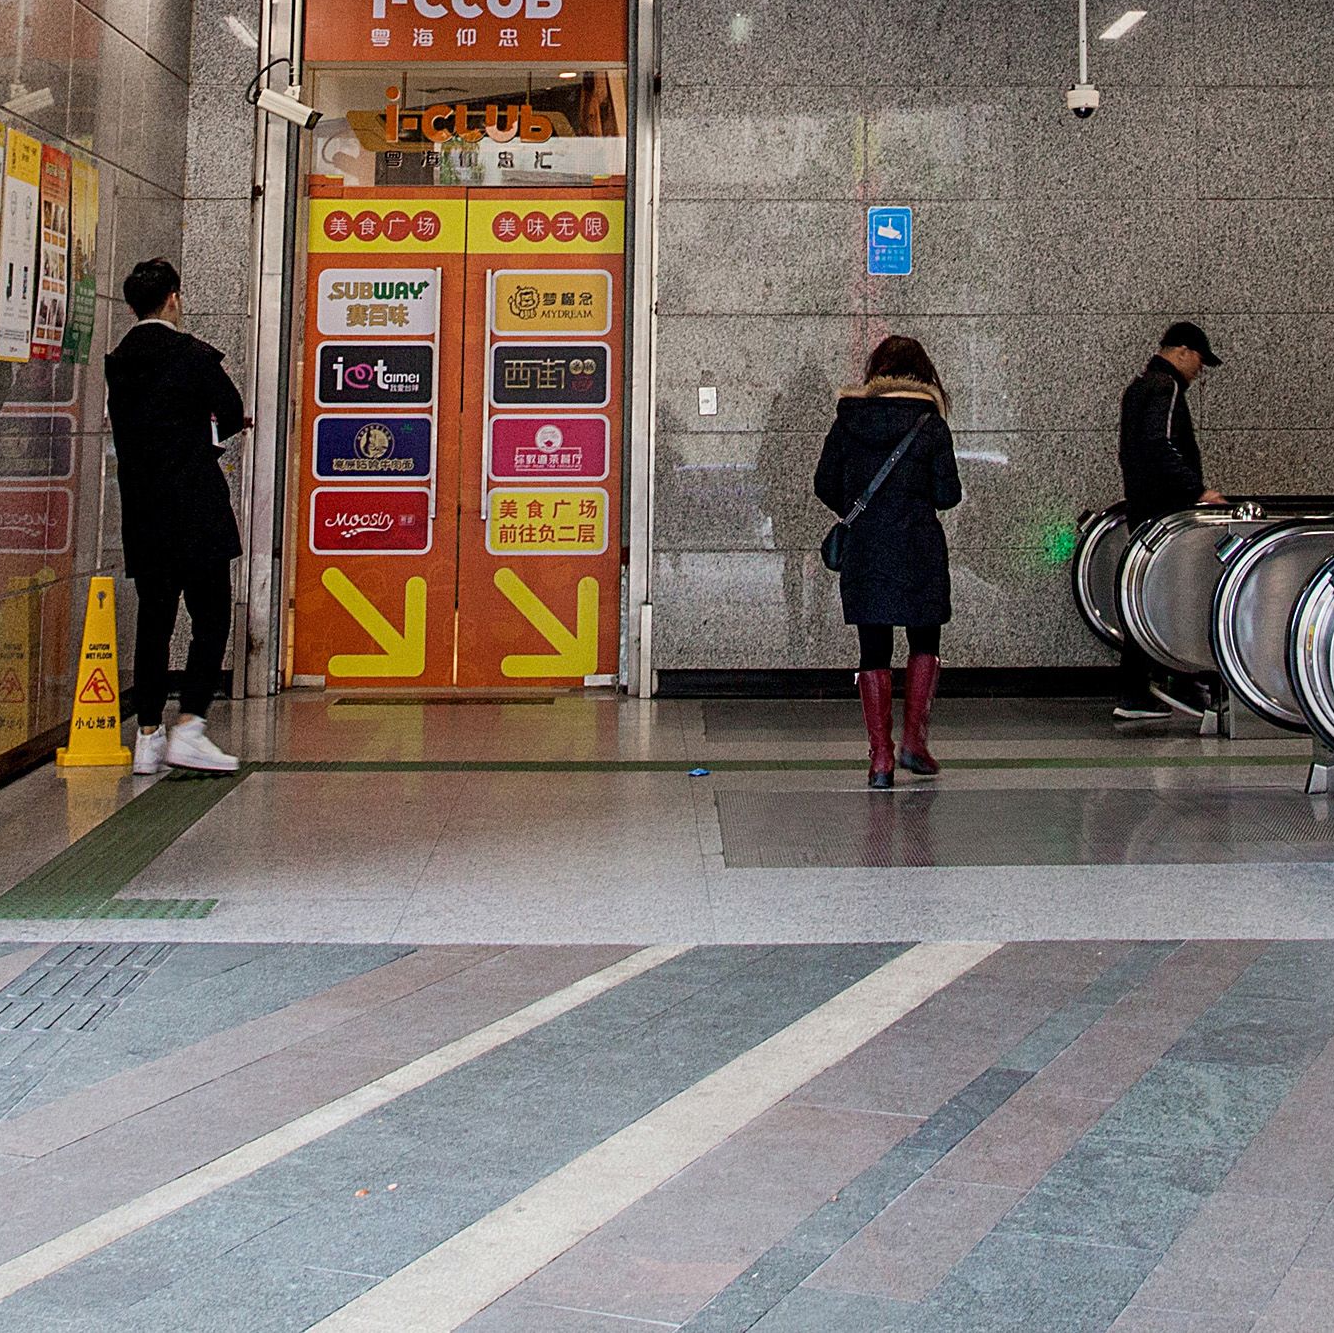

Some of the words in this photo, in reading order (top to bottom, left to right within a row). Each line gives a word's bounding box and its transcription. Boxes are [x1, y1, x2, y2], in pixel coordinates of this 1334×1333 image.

[371, 28, 562, 48] 粤海仰忠汇
[328, 217, 437, 236] 美食广场
[497, 217, 604, 237] 美味无限
[328, 281, 429, 300] SUBWAY
[346, 303, 409, 327] 赛百味
[541, 310, 593, 319] MYDREAM
[504, 358, 565, 389] 西街
[499, 499, 597, 519] 美食广场
[499, 524, 595, 543] 前往负二层
[85, 652, 95, 660] WET
[89, 643, 110, 651] CAUTION
[75, 716, 116, 730] 小心地滑
